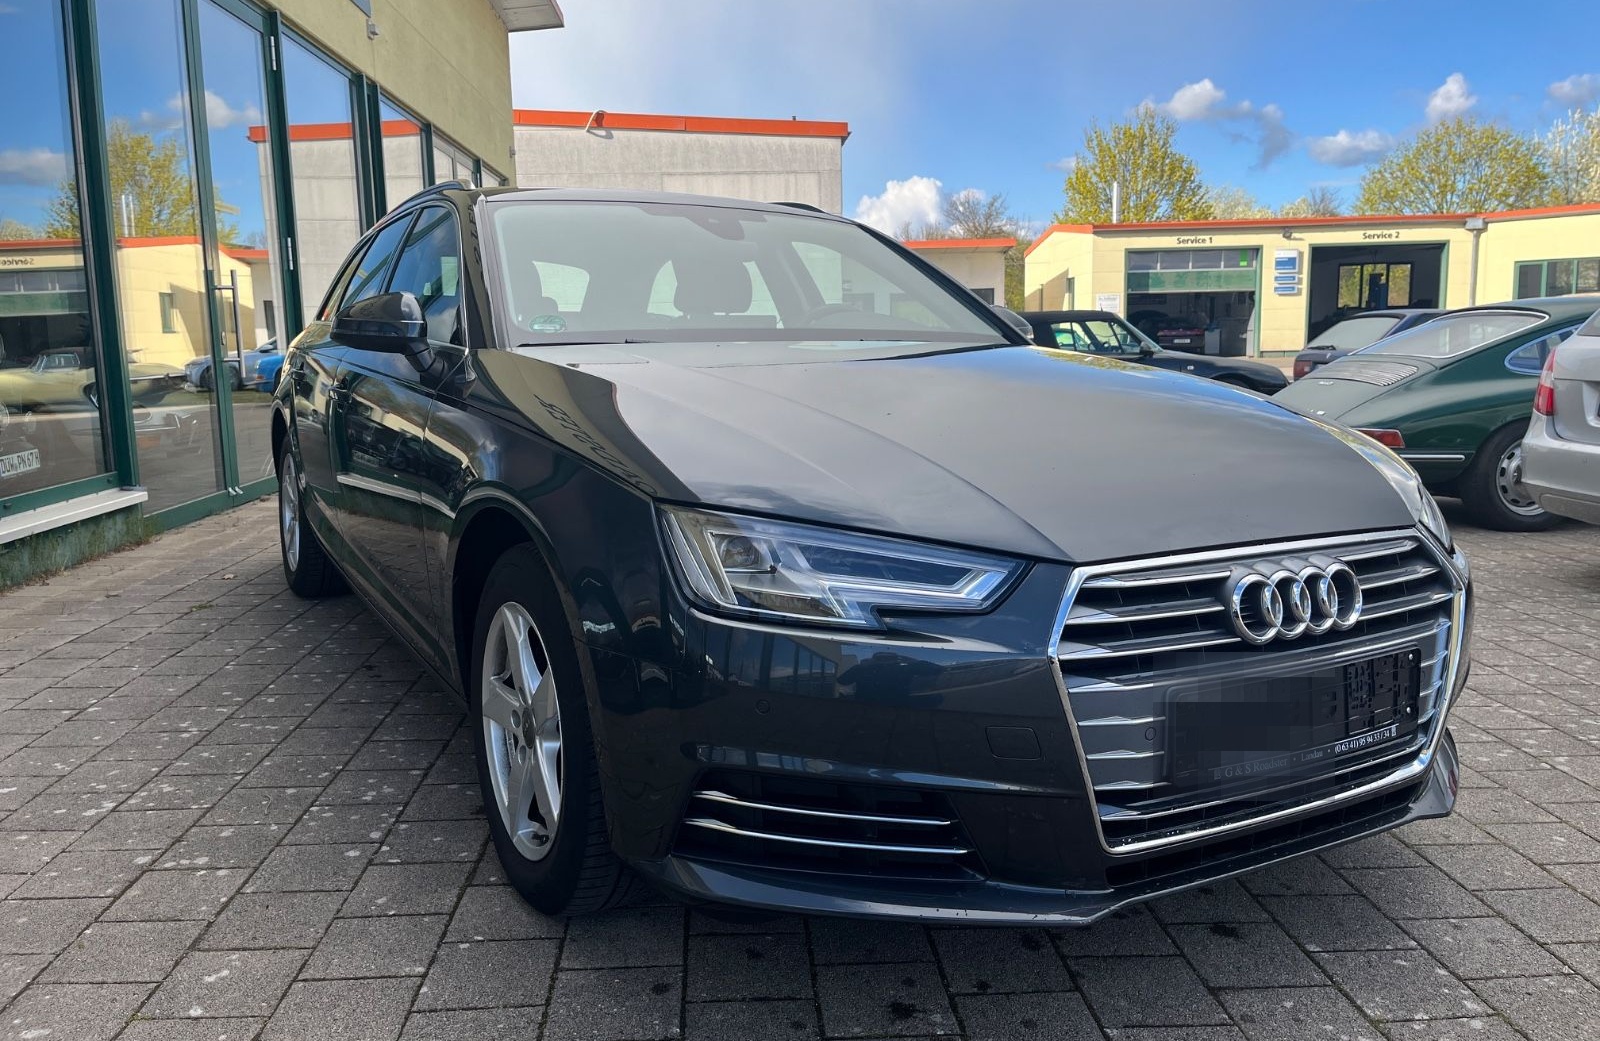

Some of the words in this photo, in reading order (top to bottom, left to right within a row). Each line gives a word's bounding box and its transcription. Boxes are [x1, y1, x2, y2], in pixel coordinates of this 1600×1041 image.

[1362, 231, 1393, 240] Service
[1395, 231, 1400, 239] 2
[1176, 237, 1207, 245] Service
[1224, 767, 1233, 778] G
[1235, 767, 1243, 776] &
[1245, 764, 1251, 774] S
[1252, 758, 1288, 773] Roadster
[1301, 749, 1323, 762] Landau
